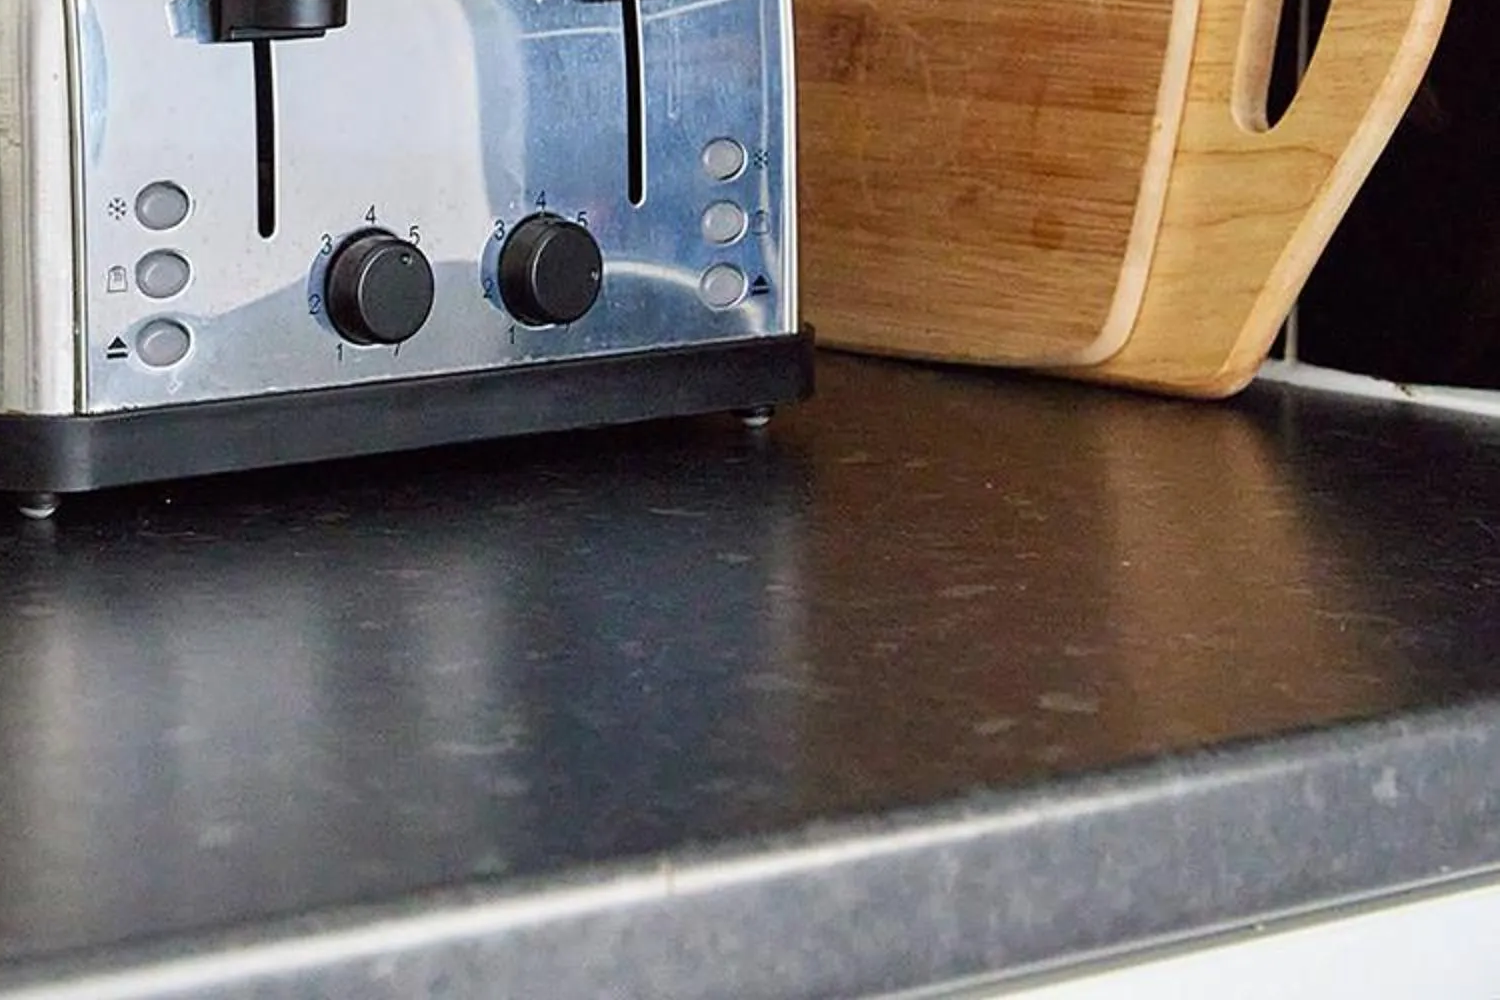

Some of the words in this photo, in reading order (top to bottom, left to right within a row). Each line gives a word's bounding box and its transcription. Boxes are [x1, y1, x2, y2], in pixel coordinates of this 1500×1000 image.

[365, 204, 376, 224] 4
[577, 211, 589, 228] 5
[409, 225, 421, 246] 5
[495, 219, 505, 240] 3
[321, 234, 333, 255] 3
[483, 278, 494, 298] 2
[309, 294, 321, 314] 2
[509, 326, 515, 344] 1
[337, 343, 344, 361] 1
